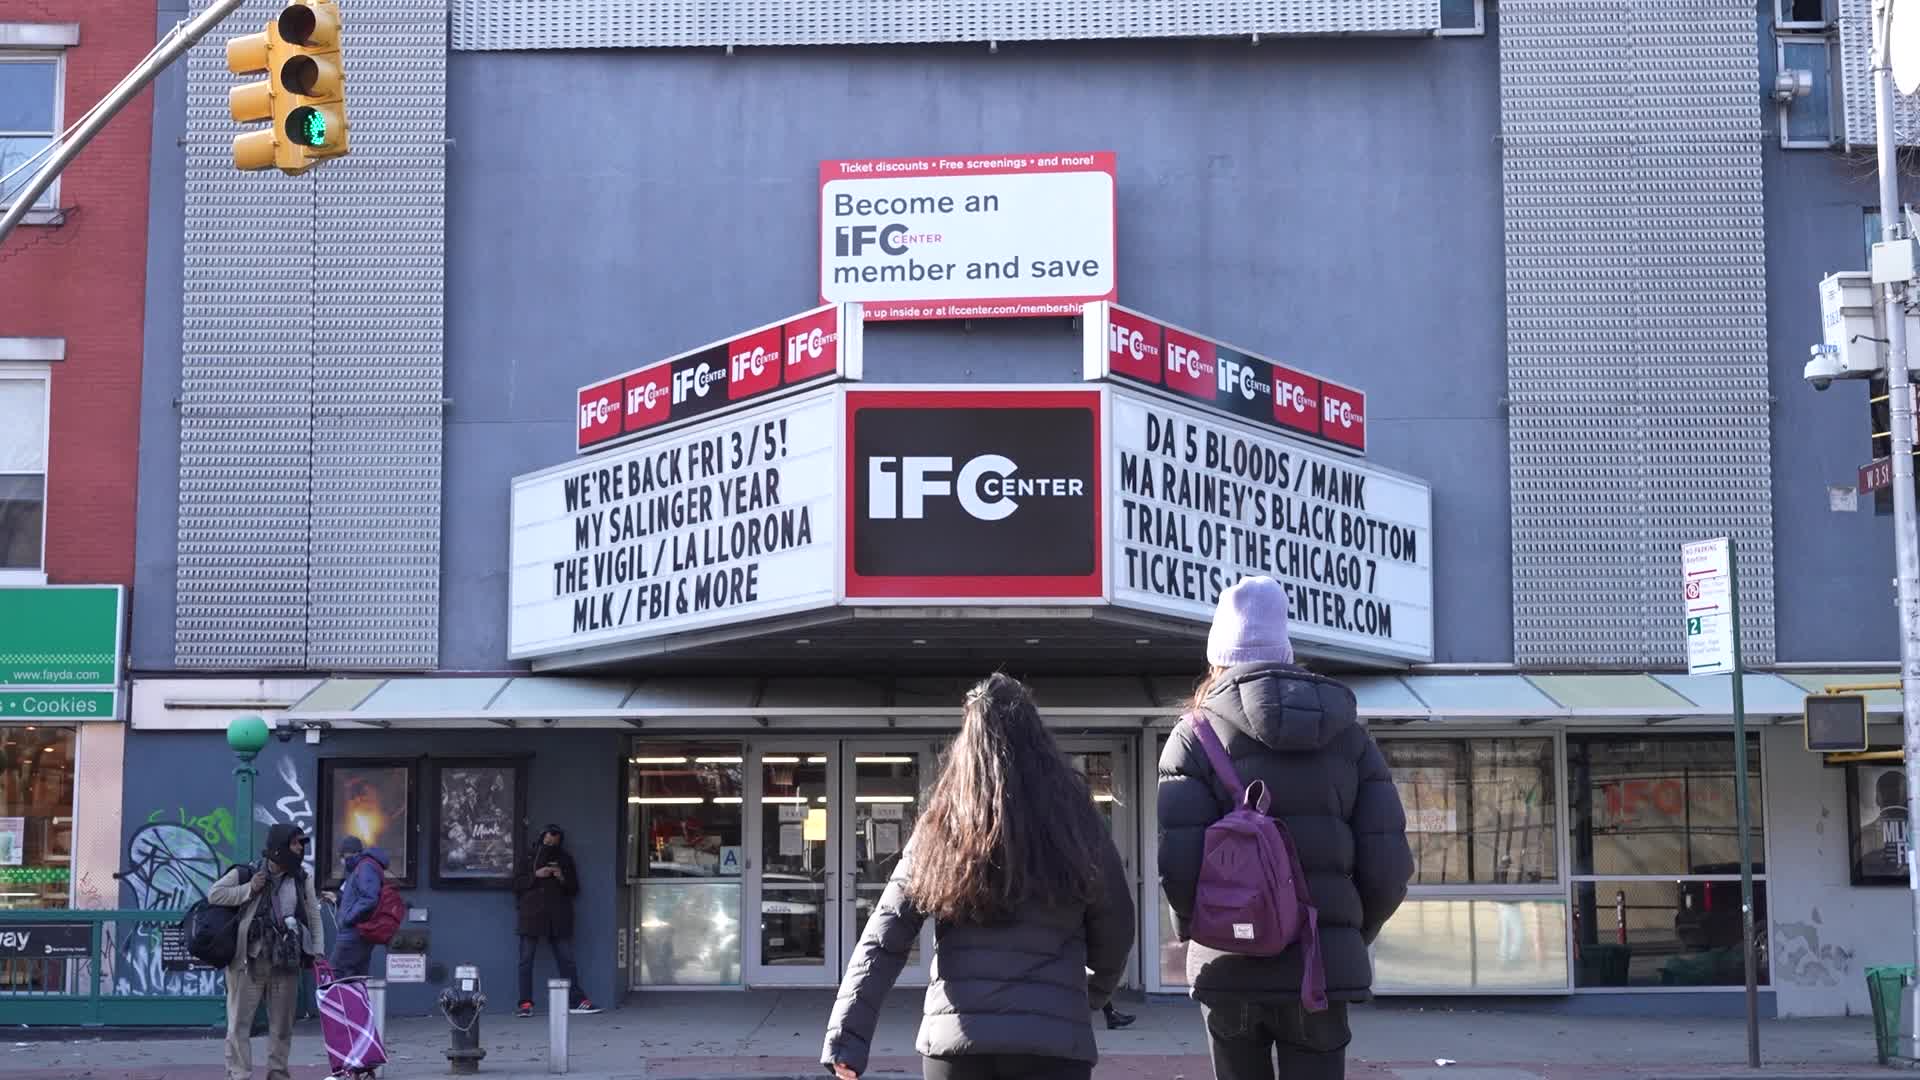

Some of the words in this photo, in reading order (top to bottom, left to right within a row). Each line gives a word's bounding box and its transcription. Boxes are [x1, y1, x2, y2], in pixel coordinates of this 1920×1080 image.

[840, 161, 873, 174] Ticket
[875, 160, 929, 172] discounts
[939, 159, 964, 170] Free
[966, 157, 1027, 170] screenings
[1037, 156, 1059, 167] and
[1061, 155, 1094, 166] more!
[835, 193, 954, 217] Become
[964, 194, 999, 213] an
[892, 234, 942, 244] CENTER
[834, 258, 956, 284] member
[965, 255, 1020, 280] and
[1031, 258, 1100, 279] save
[873, 308, 888, 321] up
[889, 306, 921, 319] inside
[923, 307, 935, 316] or
[936, 305, 946, 316] at
[948, 303, 1085, 317] ifccenter.com/membership
[1147, 412, 1176, 458] DA
[1185, 424, 1198, 463] 5
[1206, 430, 1290, 489] BLOODS
[1311, 462, 1365, 510] MANK
[564, 464, 624, 513] WE'RE
[628, 448, 682, 496] BACK
[688, 436, 724, 480] FRI
[1866, 470, 1874, 489] W
[1875, 467, 1880, 486] 3
[983, 478, 1084, 496] CENTER
[575, 511, 604, 551] MY
[609, 485, 712, 543] SALINGER
[719, 468, 780, 517] YEAR
[1121, 451, 1155, 499] MA
[1162, 463, 1267, 526] RAINEY'S
[1271, 493, 1336, 544] BLACK
[1340, 511, 1417, 563] BOTTOM
[554, 556, 589, 596] THE
[594, 544, 648, 588] VIGIL
[703, 506, 812, 566] LLORONA
[1123, 499, 1193, 553] TRIAL
[1199, 519, 1227, 561] OF
[1230, 527, 1271, 572] THE
[1275, 538, 1362, 590] CHICAGO
[1366, 559, 1377, 594] 7
[573, 591, 614, 634] MLK
[637, 581, 671, 622] FBI
[676, 577, 688, 614] &
[694, 563, 759, 612] MORE
[1690, 618, 1699, 634] 2
[13, 669, 100, 682] www.fayda.com
[23, 696, 97, 713] Cookies
[724, 850, 738, 865] A
